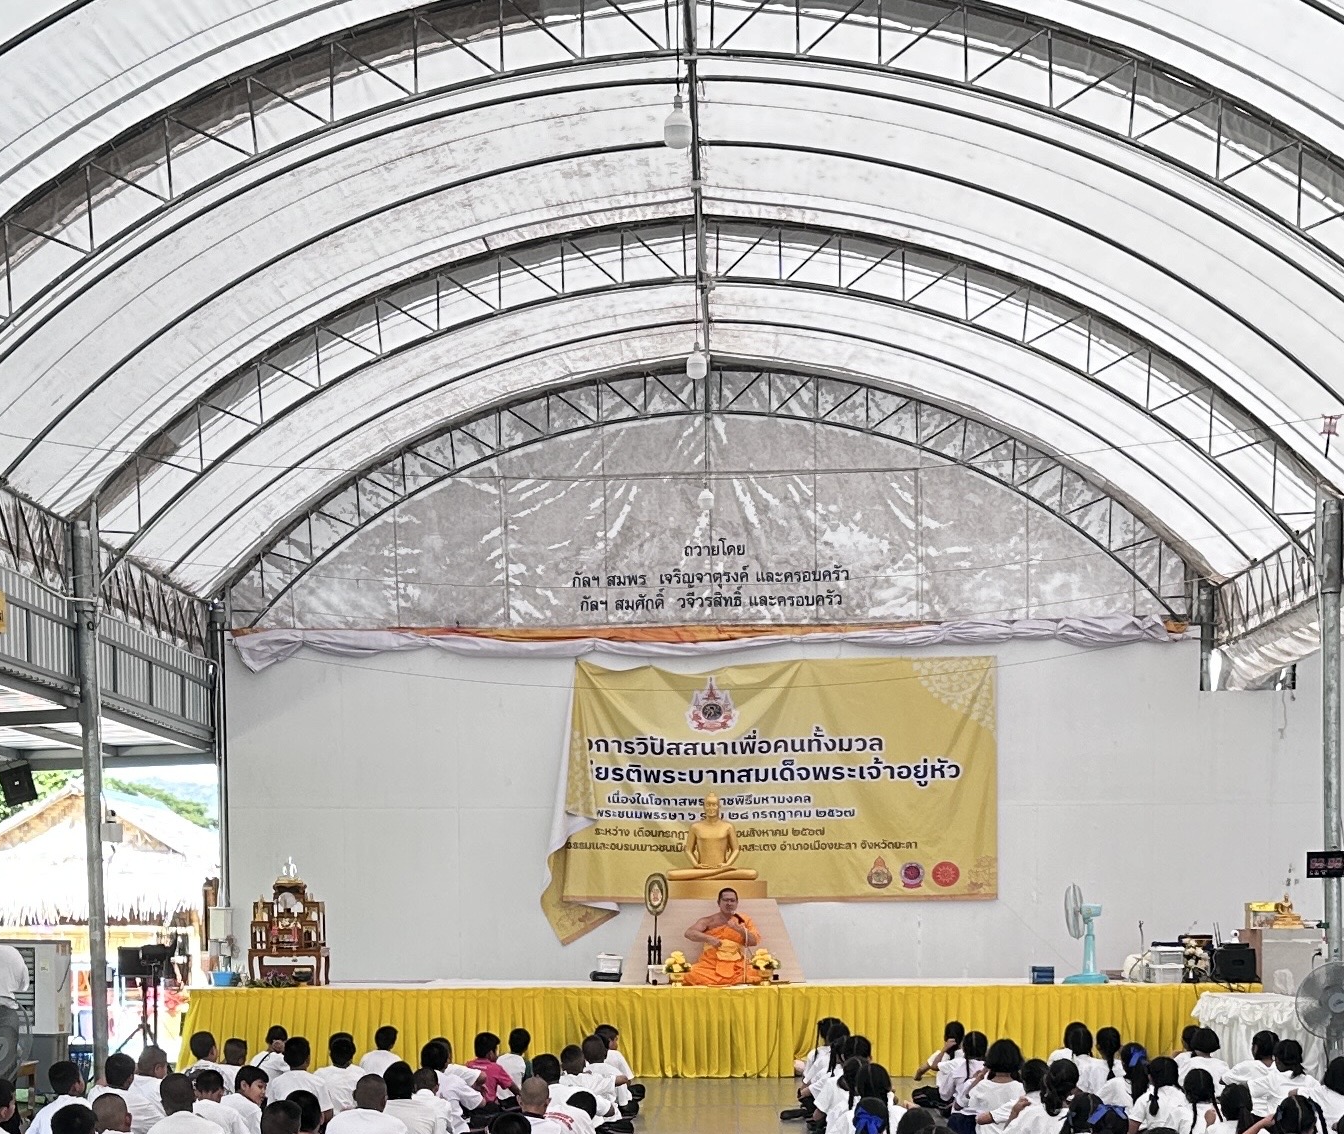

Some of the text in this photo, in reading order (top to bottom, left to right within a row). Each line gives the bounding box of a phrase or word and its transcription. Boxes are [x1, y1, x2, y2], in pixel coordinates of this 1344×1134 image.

[684, 538, 745, 556] ถวายโดย
[572, 565, 849, 589] กัลฯ สมพร เจริญจาตุรงค์ และครอบครัว
[580, 595, 608, 611] กัลฯ
[615, 588, 665, 611] สมศักดิ์
[749, 590, 843, 608] และครอบครัว
[590, 758, 961, 787] ยรติพระบาทสมเด็จพระเจ้าอยู่หัว
[608, 790, 812, 807] เนื่องในโอกาสพราชพิธีมหามงคล
